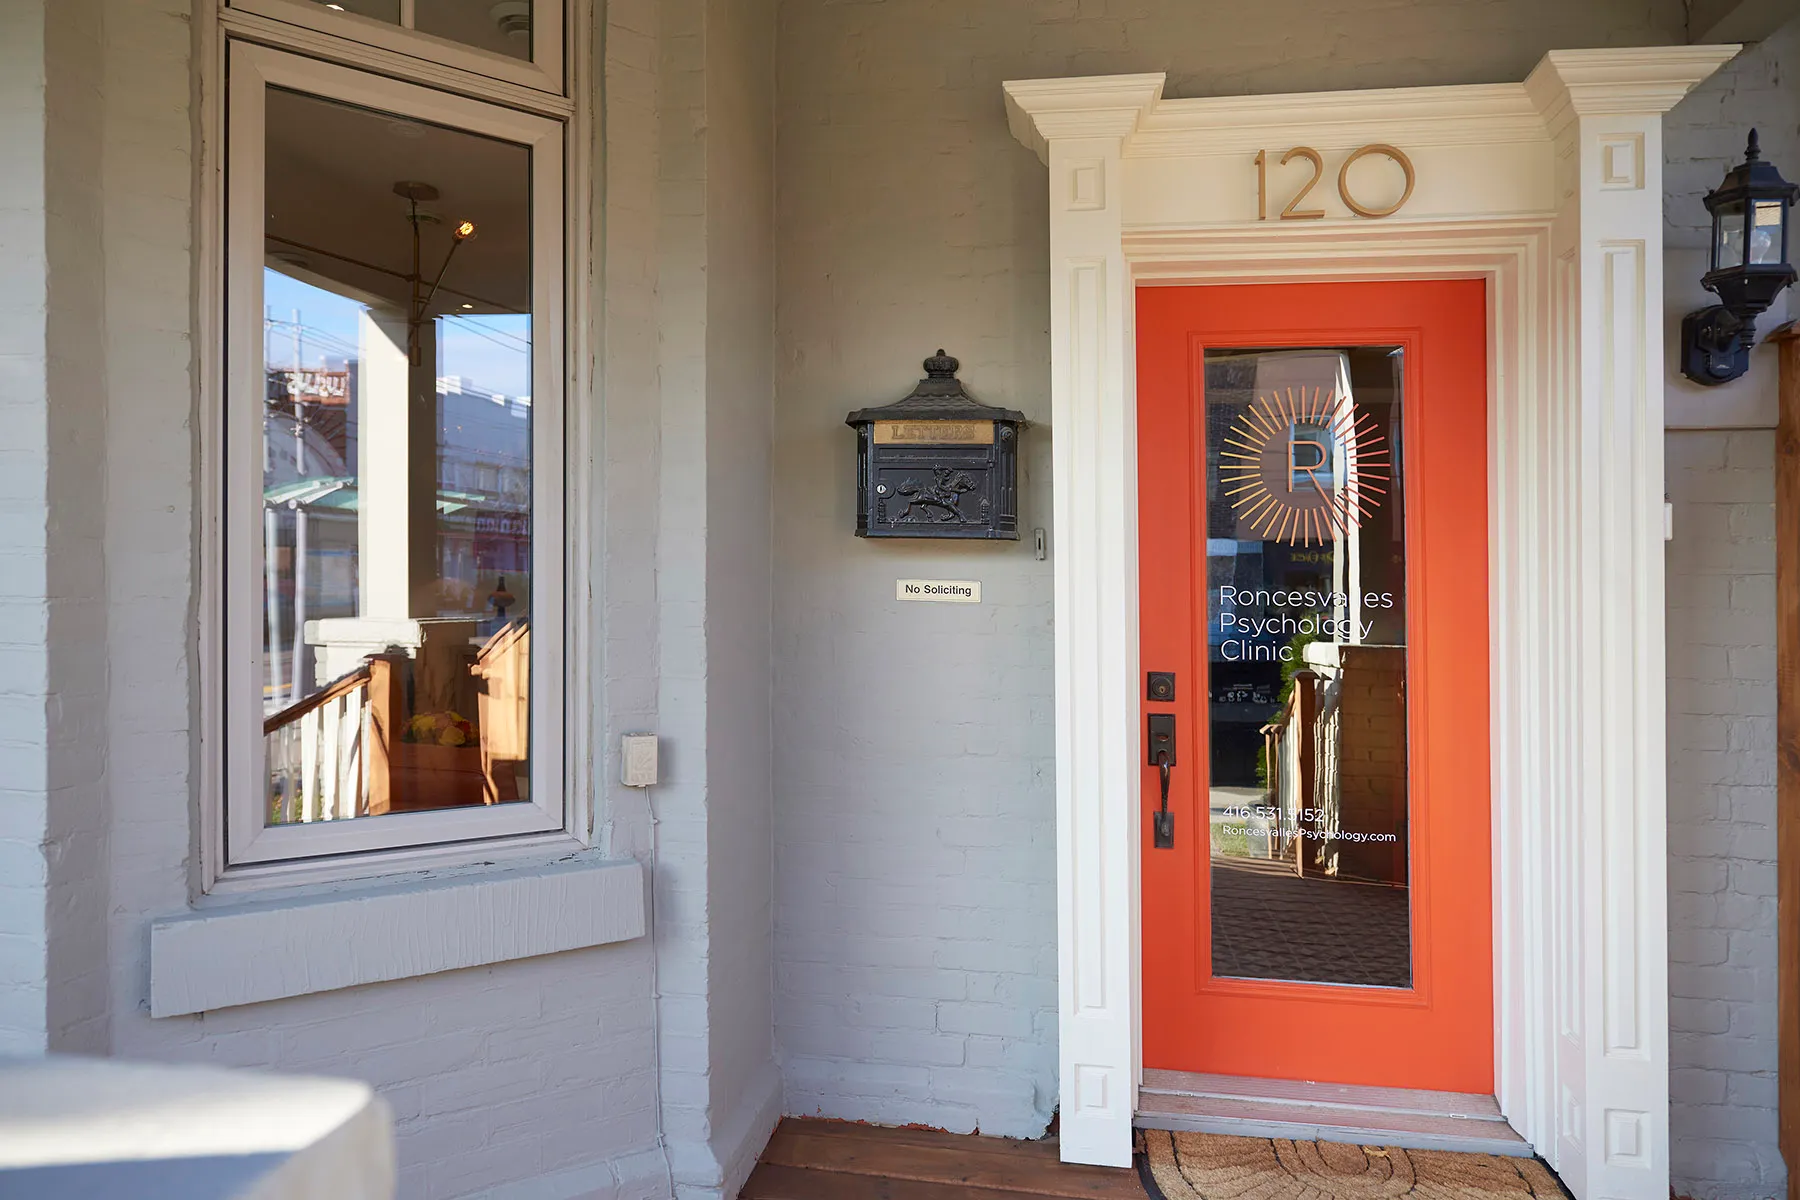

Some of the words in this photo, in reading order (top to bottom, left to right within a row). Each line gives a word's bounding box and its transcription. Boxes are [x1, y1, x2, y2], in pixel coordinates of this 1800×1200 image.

[1255, 143, 1416, 220] 120
[892, 425, 975, 440] LETTERS
[1287, 440, 1350, 536] R
[905, 584, 921, 594] No
[924, 585, 972, 597] Soliciting
[1220, 585, 1394, 609] Roncesvaes
[1220, 612, 1374, 640] Psychology
[1220, 639, 1294, 662] Clinic
[1222, 805, 1326, 822] 416.531.5152
[1222, 825, 1397, 843] RoncesvallesPsychology.com
